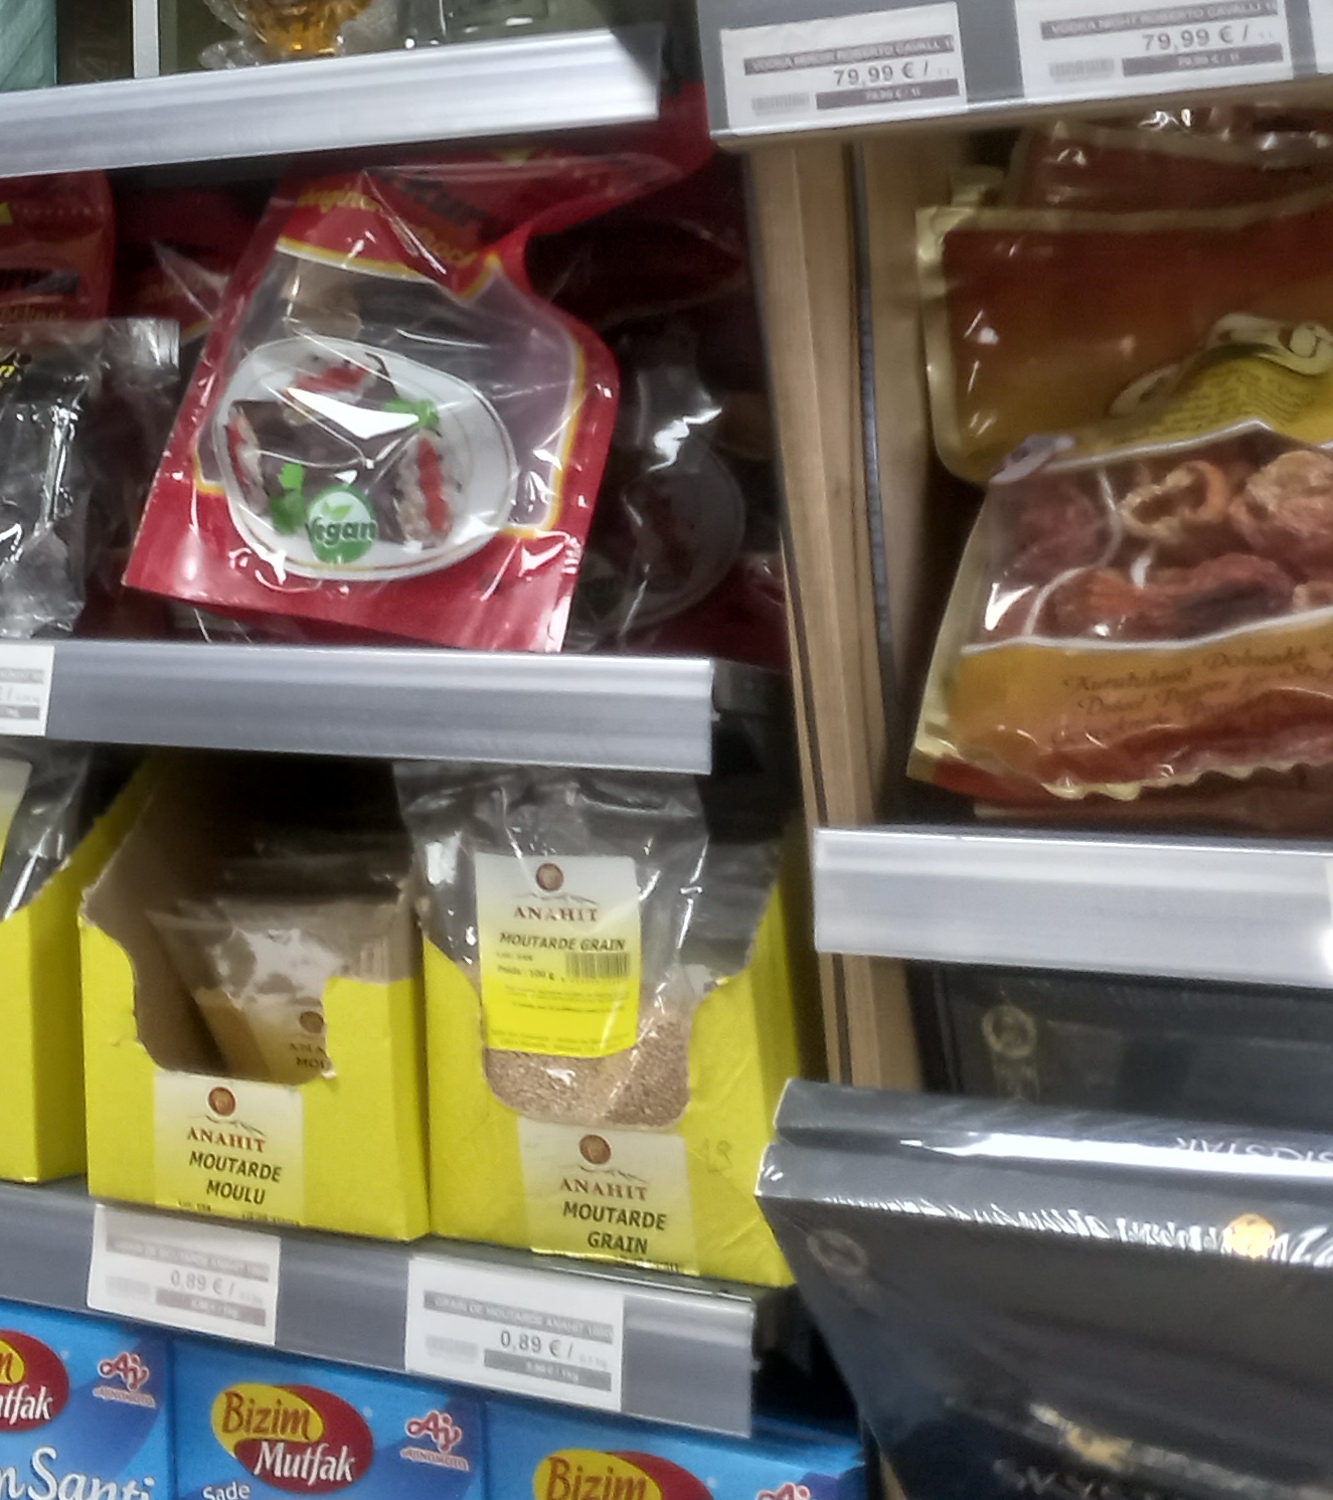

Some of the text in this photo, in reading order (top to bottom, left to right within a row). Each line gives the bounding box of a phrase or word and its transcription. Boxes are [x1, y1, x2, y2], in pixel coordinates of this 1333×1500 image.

[1141, 29, 1210, 52] 79,99
[1218, 25, 1233, 45] €
[833, 63, 894, 88] 79,99
[902, 61, 914, 79] €
[514, 906, 598, 922] ANAHIT
[499, 931, 626, 951] MOUTARDE GRAIN
[187, 1127, 267, 1153] ANAHIT
[189, 1150, 282, 1183] MOUTARDE
[206, 1179, 266, 1206] MOULU
[560, 1177, 649, 1200] ANAHIT
[562, 1200, 667, 1232] MOUTARDE
[586, 1231, 649, 1254] GRAIN
[169, 1269, 207, 1292] 0,89
[500, 1329, 542, 1353] 0,89
[548, 1338, 562, 1358] €
[220, 1391, 313, 1442] Bizim
[252, 1439, 357, 1487] Mutfak
[546, 1455, 648, 1500] Bizim
